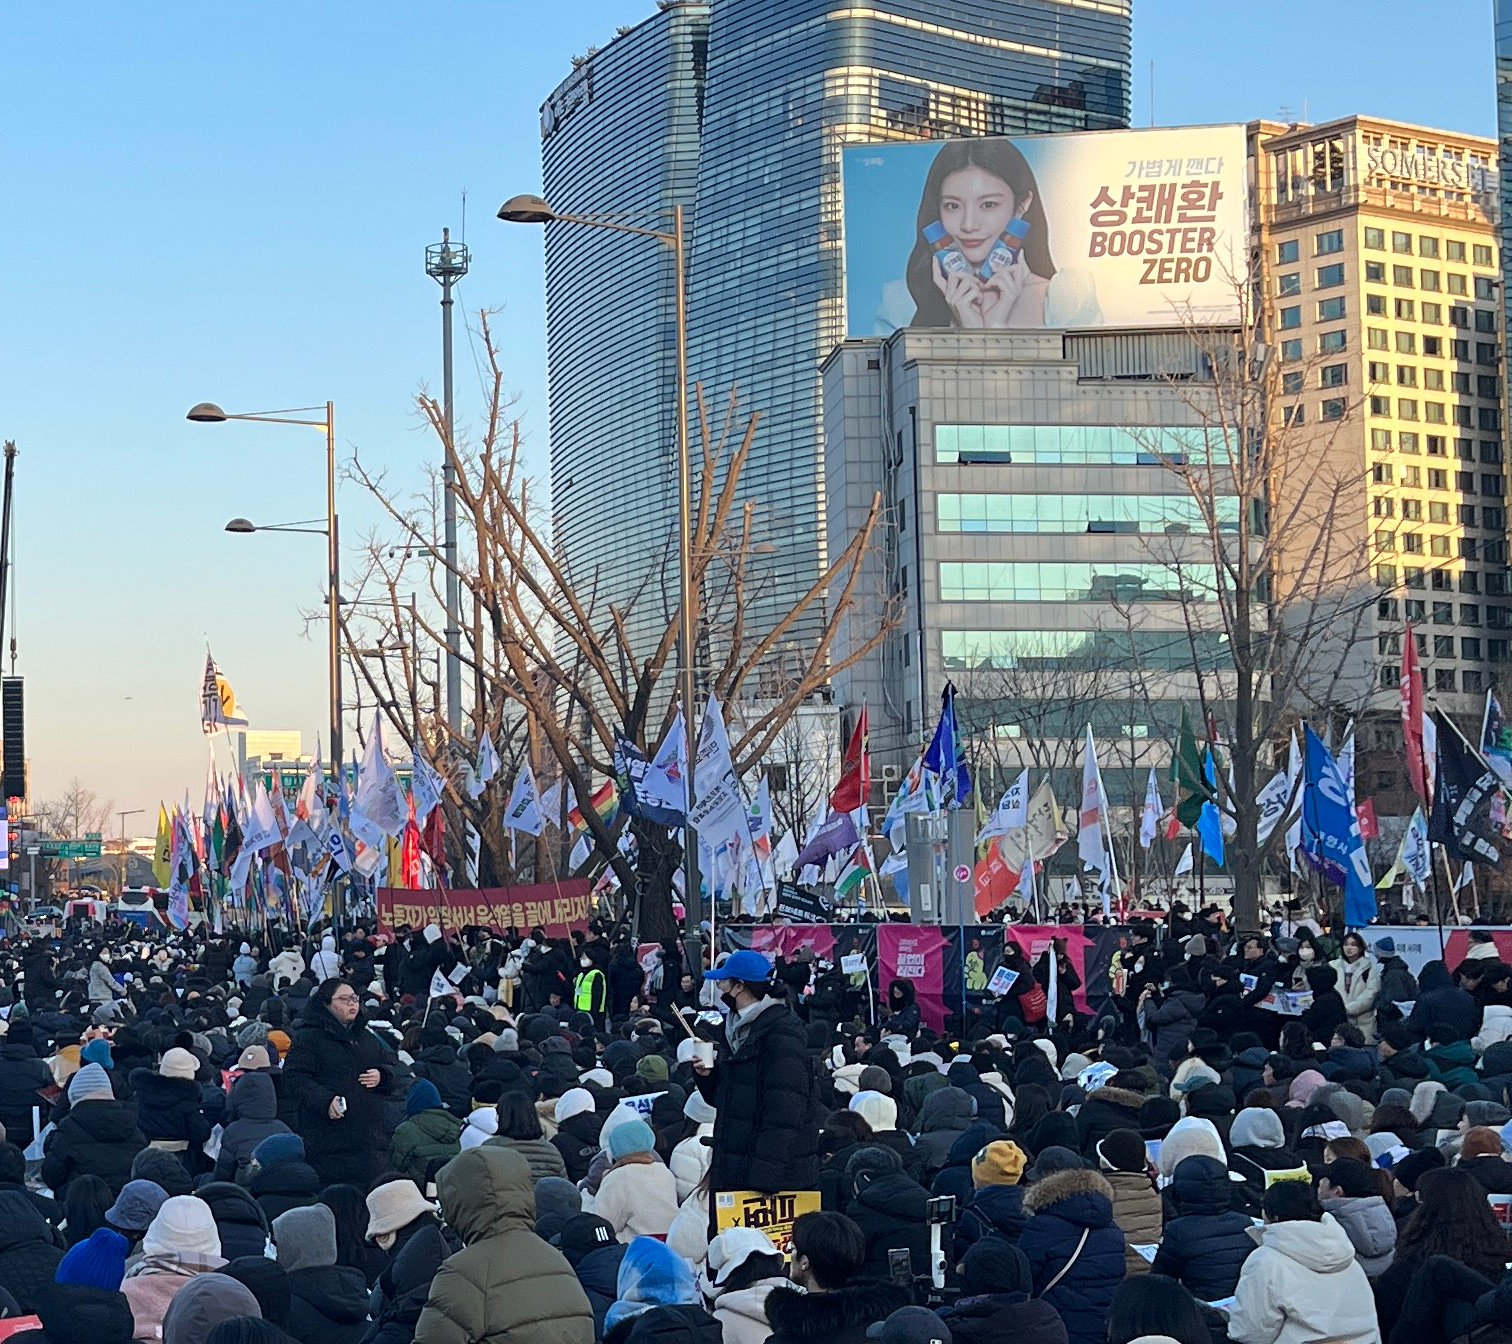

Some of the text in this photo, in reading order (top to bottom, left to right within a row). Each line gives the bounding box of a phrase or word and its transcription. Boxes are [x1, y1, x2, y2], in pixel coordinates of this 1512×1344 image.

[1125, 157, 1224, 178] 가볍게 깬다
[1090, 180, 1224, 227] 상쾌환
[1089, 227, 1216, 257] BOOSTER
[1139, 256, 1212, 285] ZERO
[382, 904, 427, 927] 노동자가
